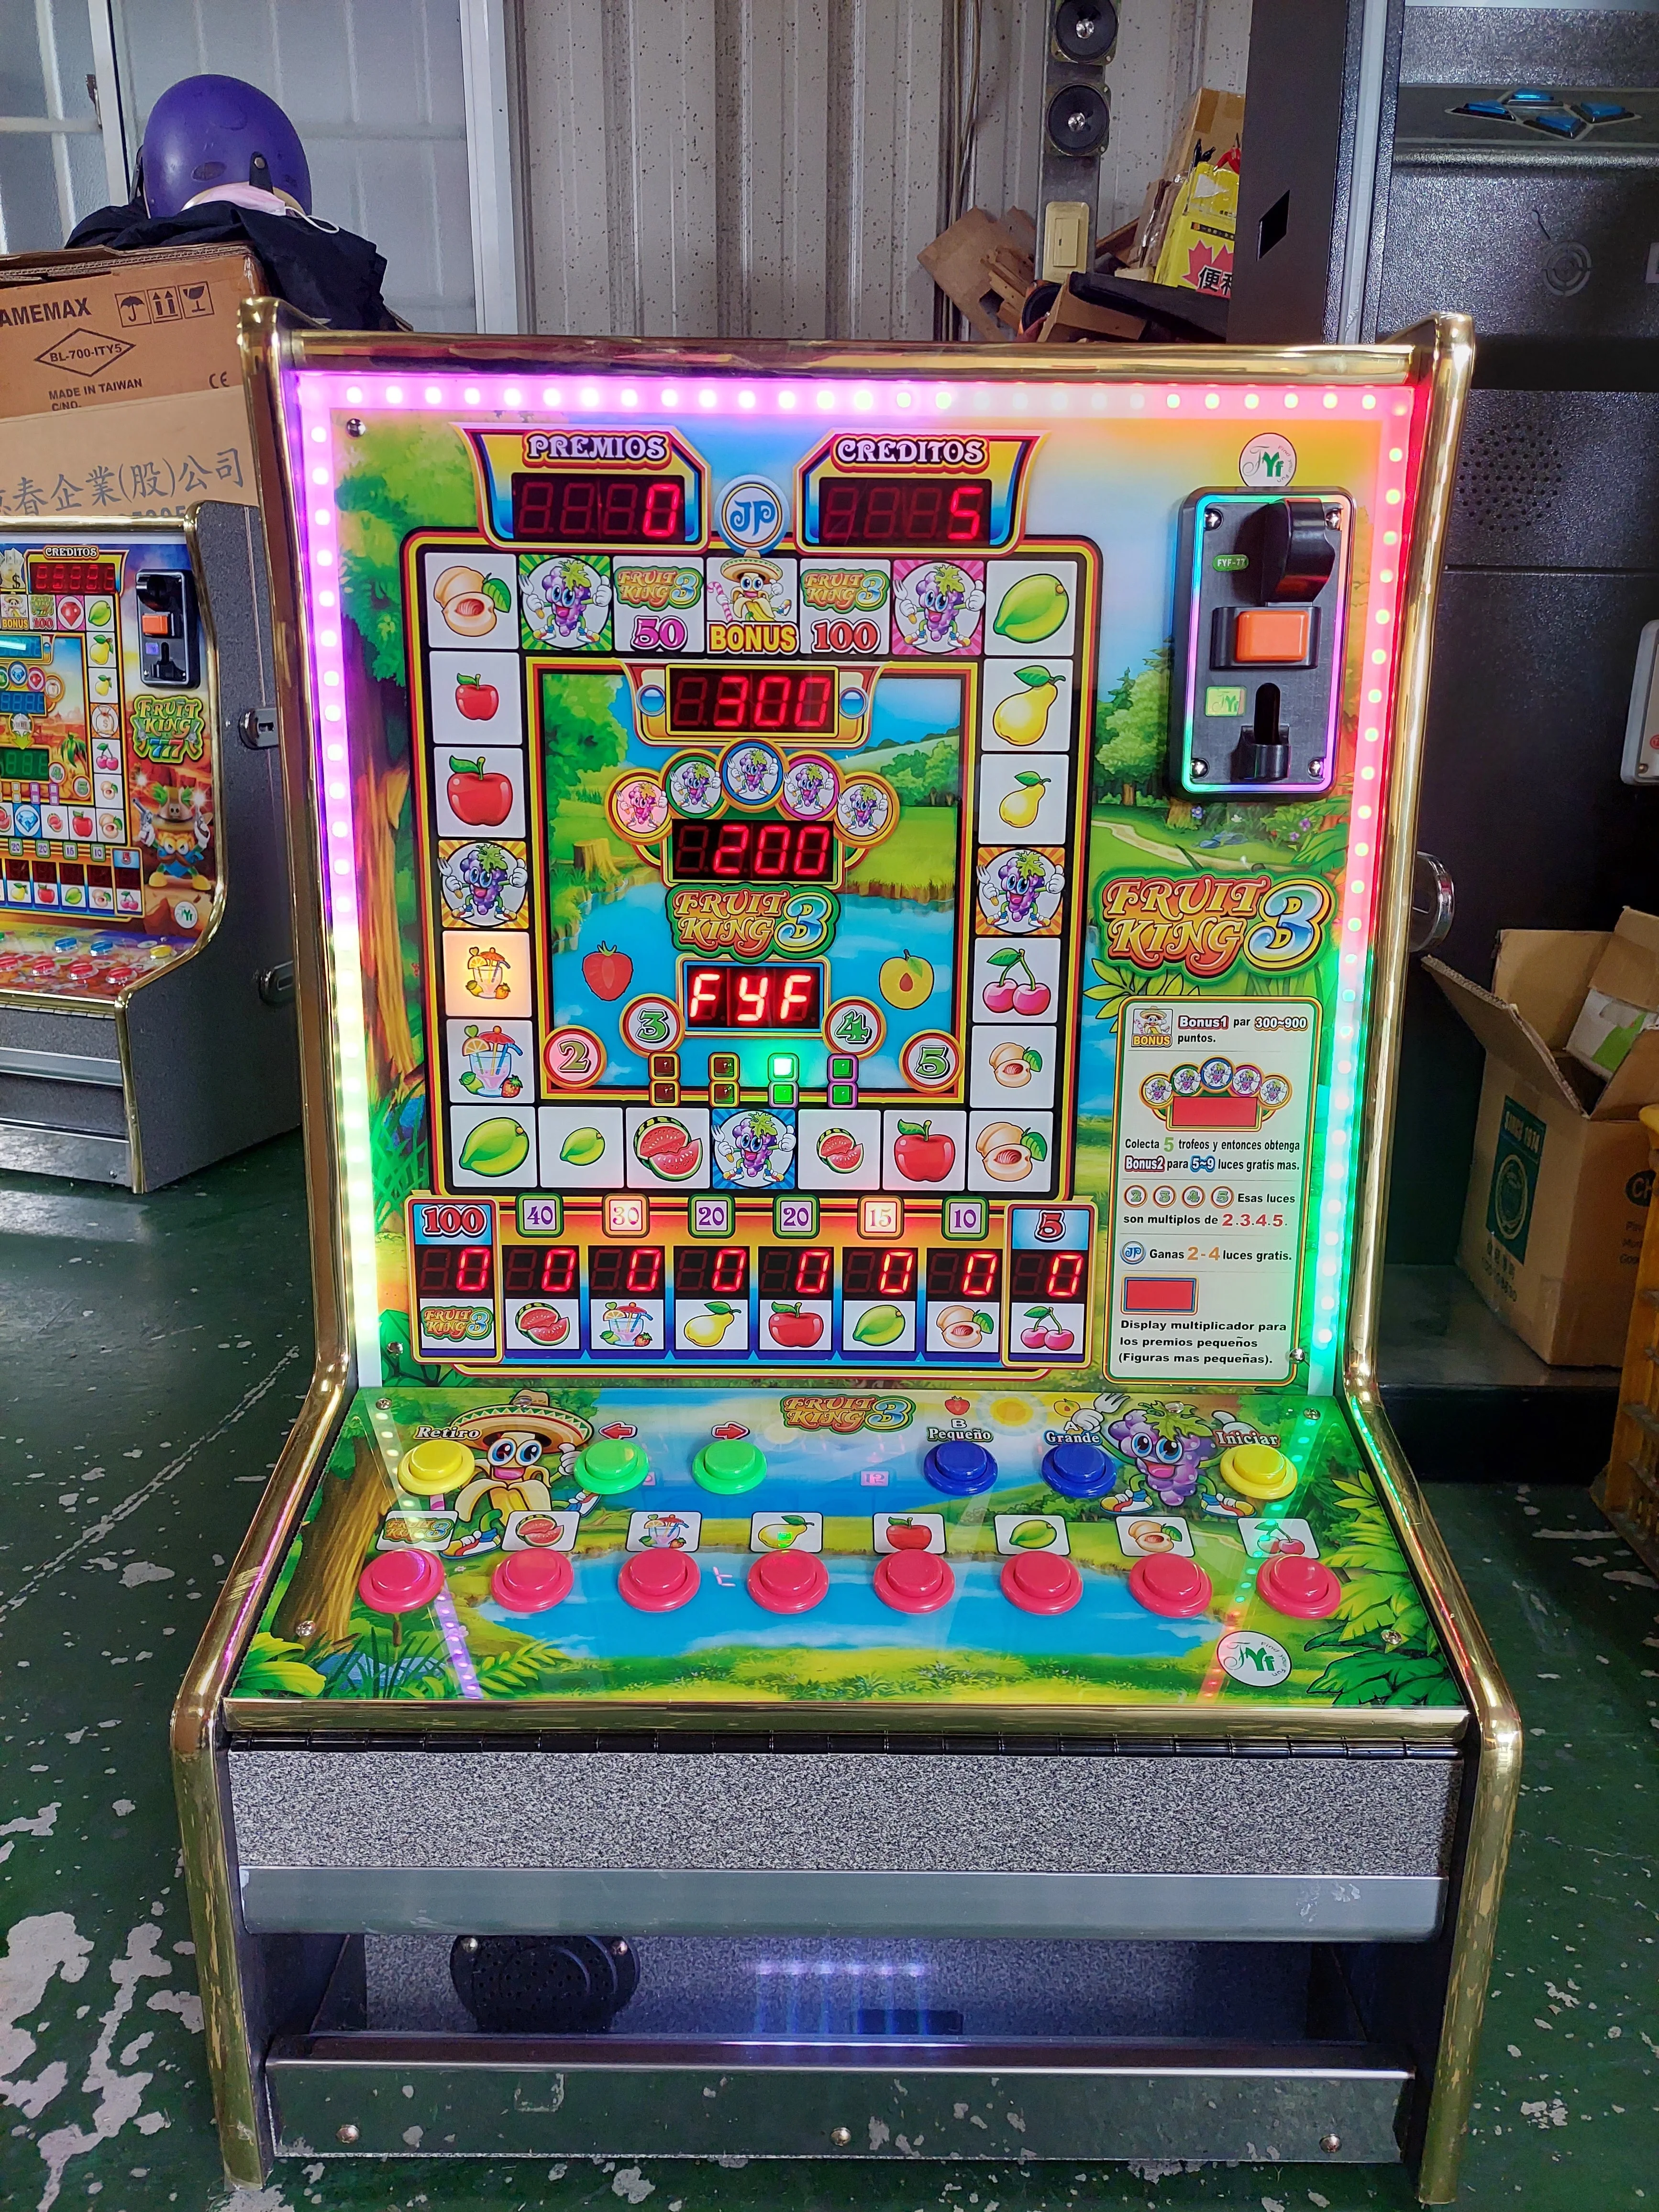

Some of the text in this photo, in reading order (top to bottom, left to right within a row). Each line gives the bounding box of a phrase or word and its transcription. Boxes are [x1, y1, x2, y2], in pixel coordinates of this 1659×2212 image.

[50, 343, 122, 362] BL-700-ITY5
[49, 378, 142, 399] MADE IN TAIWAN
[528, 435, 665, 459] PREMIOS
[837, 439, 984, 463] CREDITOS
[642, 483, 679, 537] 0
[730, 500, 775, 537] JP
[947, 487, 983, 541] 5
[45, 547, 98, 557] CREDITOS
[619, 571, 676, 586] FRUIT
[806, 573, 863, 589] FRUIT
[622, 574, 697, 605] KING 3
[808, 576, 883, 608] KING 3
[2, 619, 29, 629] BONUS
[33, 618, 54, 628] 100
[633, 618, 686, 647] 50
[711, 625, 796, 652] BONUS
[814, 621, 878, 651] 100
[138, 700, 197, 719] FRUIT
[714, 676, 831, 727] 300
[144, 718, 191, 738] KING
[150, 739, 184, 757] 777
[11, 843, 20, 851] 20
[38, 845, 47, 853] 20
[94, 849, 102, 857] 10
[714, 825, 830, 874] 200
[675, 891, 787, 918] FRUIT
[1106, 878, 1266, 920] FRUIT
[679, 896, 828, 951] KING 3
[1112, 884, 1324, 970] KING 3
[636, 1008, 670, 1043] 3
[836, 1010, 873, 1045] 4
[1179, 1017, 1307, 1029] Bonus1 par 300~900
[1133, 1035, 1171, 1046] BONUS
[1178, 1033, 1216, 1044] puntos.
[557, 1040, 592, 1073] 2
[915, 1044, 951, 1079] 5
[1125, 1137, 1300, 1152] Colecta 5 trofeos y entonces obtenga
[1126, 1157, 1299, 1172] Bonus2 para 5~9 luces gratis mas.
[1130, 1190, 1295, 1203] 2 3 4 5 Esas luces
[424, 1206, 486, 1235] 100
[527, 1206, 553, 1225] 40
[612, 1206, 640, 1226] 30
[698, 1207, 724, 1226] 20
[783, 1207, 809, 1227] 20
[870, 1208, 892, 1228] 15
[954, 1209, 976, 1228] 10
[1036, 1211, 1064, 1240] 5
[1148, 1215, 1200, 1226] multiplos
[1205, 1216, 1218, 1224] de
[1125, 1247, 1142, 1258] JP
[1150, 1250, 1184, 1259] Ganas
[1223, 1250, 1252, 1260] luces
[1256, 1250, 1292, 1262] gratis.
[456, 1248, 490, 1292] 0
[542, 1248, 576, 1292] 0
[626, 1249, 661, 1292] 0
[711, 1249, 746, 1292] 0
[795, 1251, 830, 1293] 0
[879, 1251, 913, 1294] 0
[962, 1253, 997, 1295] 0
[1047, 1254, 1083, 1297] 0
[425, 1310, 471, 1322] FRUIT
[427, 1312, 488, 1337] KING 3
[1121, 1320, 1286, 1332] Display multiplicador para
[1142, 1338, 1193, 1347] premios
[1197, 1337, 1257, 1349] pequeños
[1118, 1353, 1169, 1363] (Figuras
[1204, 1353, 1272, 1364] pequeñas).
[785, 1397, 875, 1412] FRUIT
[787, 1399, 907, 1429] KING 3
[416, 1427, 480, 1438] Retiro
[951, 1419, 967, 1428] B
[1064, 1422, 1079, 1430] A
[929, 1429, 991, 1441] Pequeño
[1046, 1432, 1100, 1443] Grande
[1217, 1432, 1278, 1445] Iniciar
[427, 1523, 449, 1537] 3
